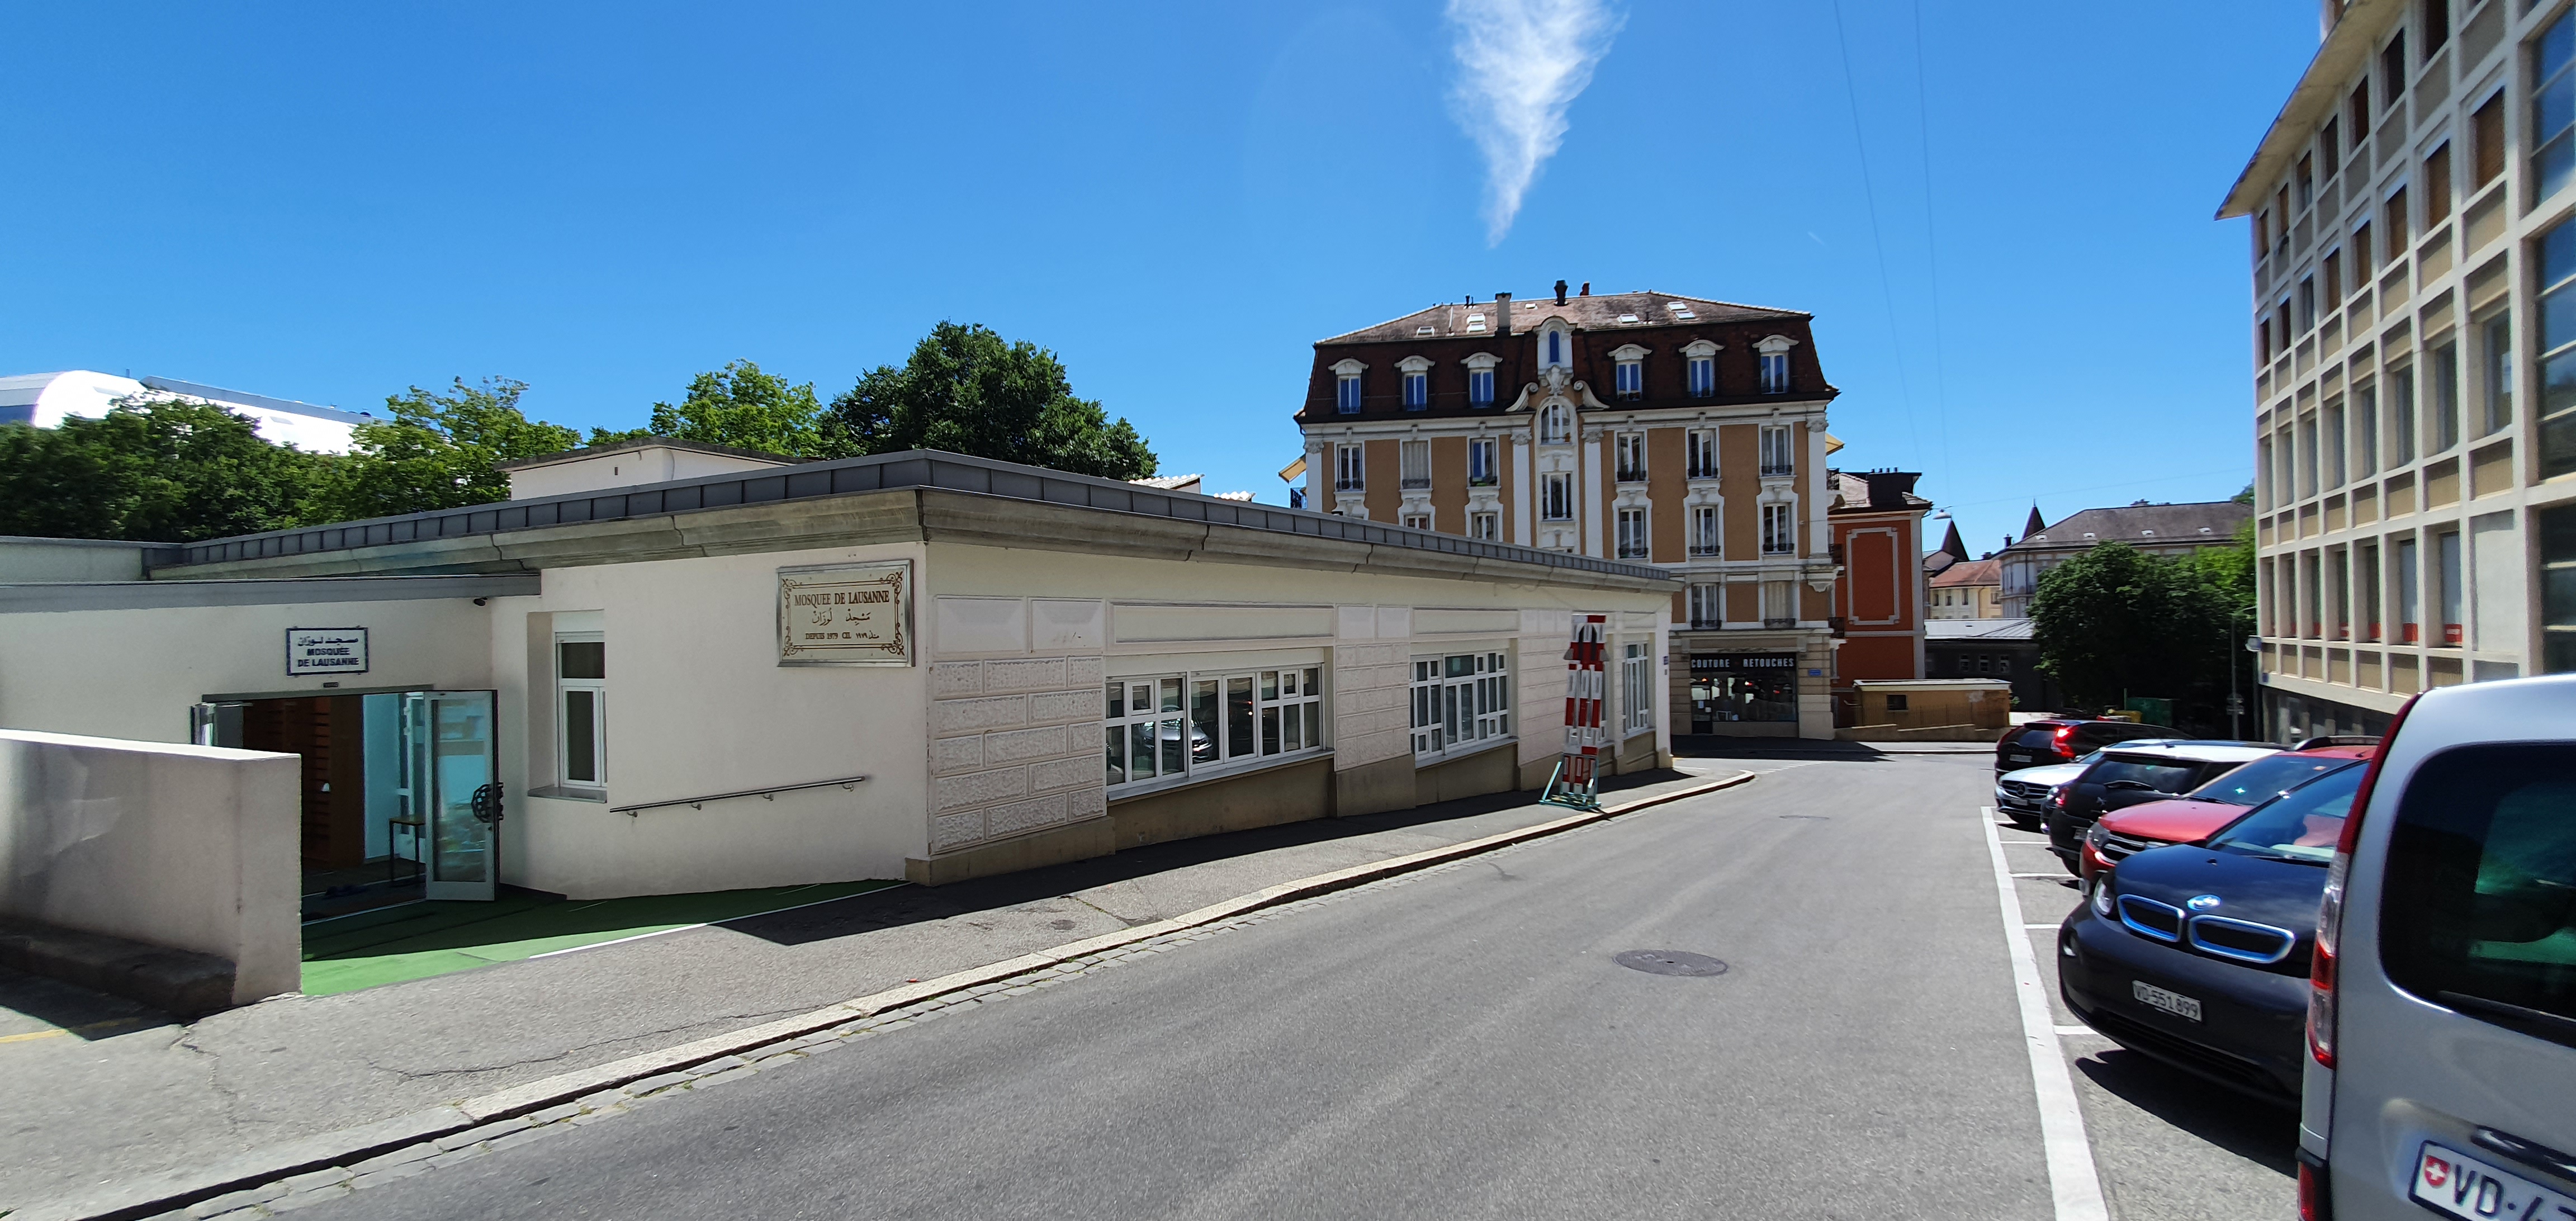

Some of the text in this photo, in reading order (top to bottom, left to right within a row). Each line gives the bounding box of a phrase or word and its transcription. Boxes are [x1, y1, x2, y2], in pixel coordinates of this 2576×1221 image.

[794, 590, 890, 608] MOSQUEE DE LAUSANNE
[297, 657, 359, 667] DE LAUSANNE
[1691, 658, 1794, 668] COUTURE RETOUCHES
